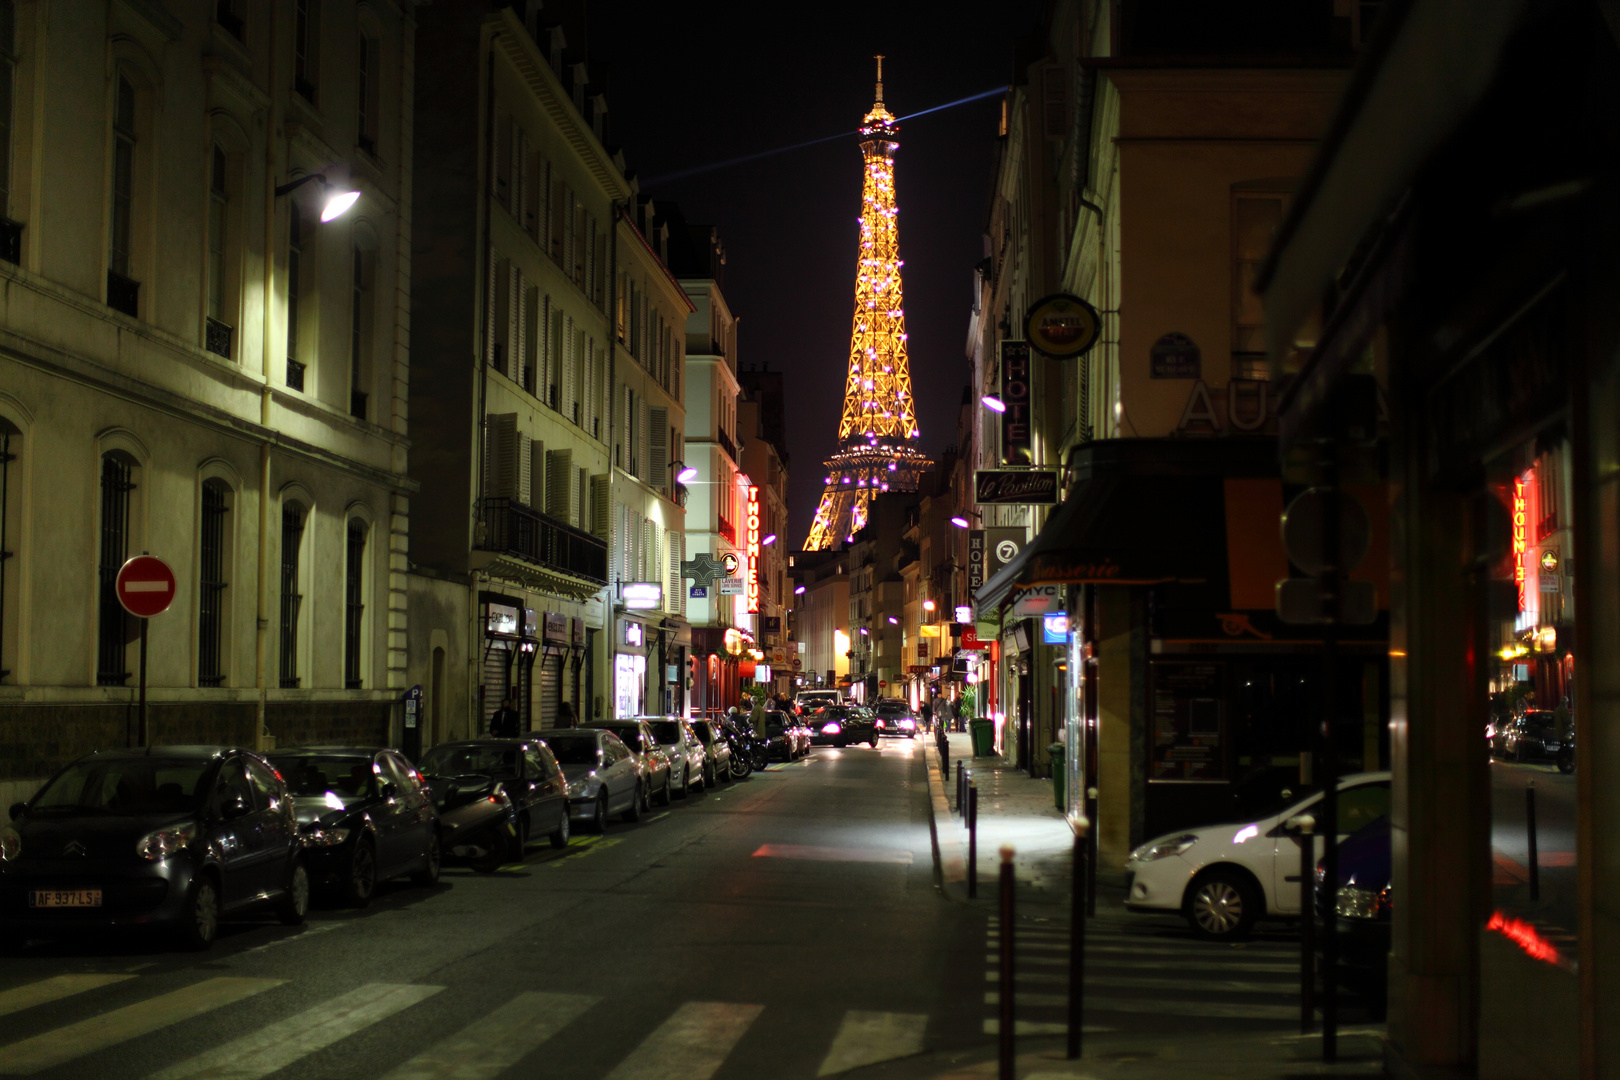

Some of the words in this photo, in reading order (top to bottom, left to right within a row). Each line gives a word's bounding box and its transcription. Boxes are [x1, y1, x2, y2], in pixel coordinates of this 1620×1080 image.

[1041, 316, 1082, 328] AMSTEL
[1006, 360, 1027, 465] HOTEL
[1177, 379, 1269, 431] AU
[997, 472, 1054, 495] Pavillon
[747, 486, 759, 612] THOUMIEUX
[412, 689, 418, 698] P
